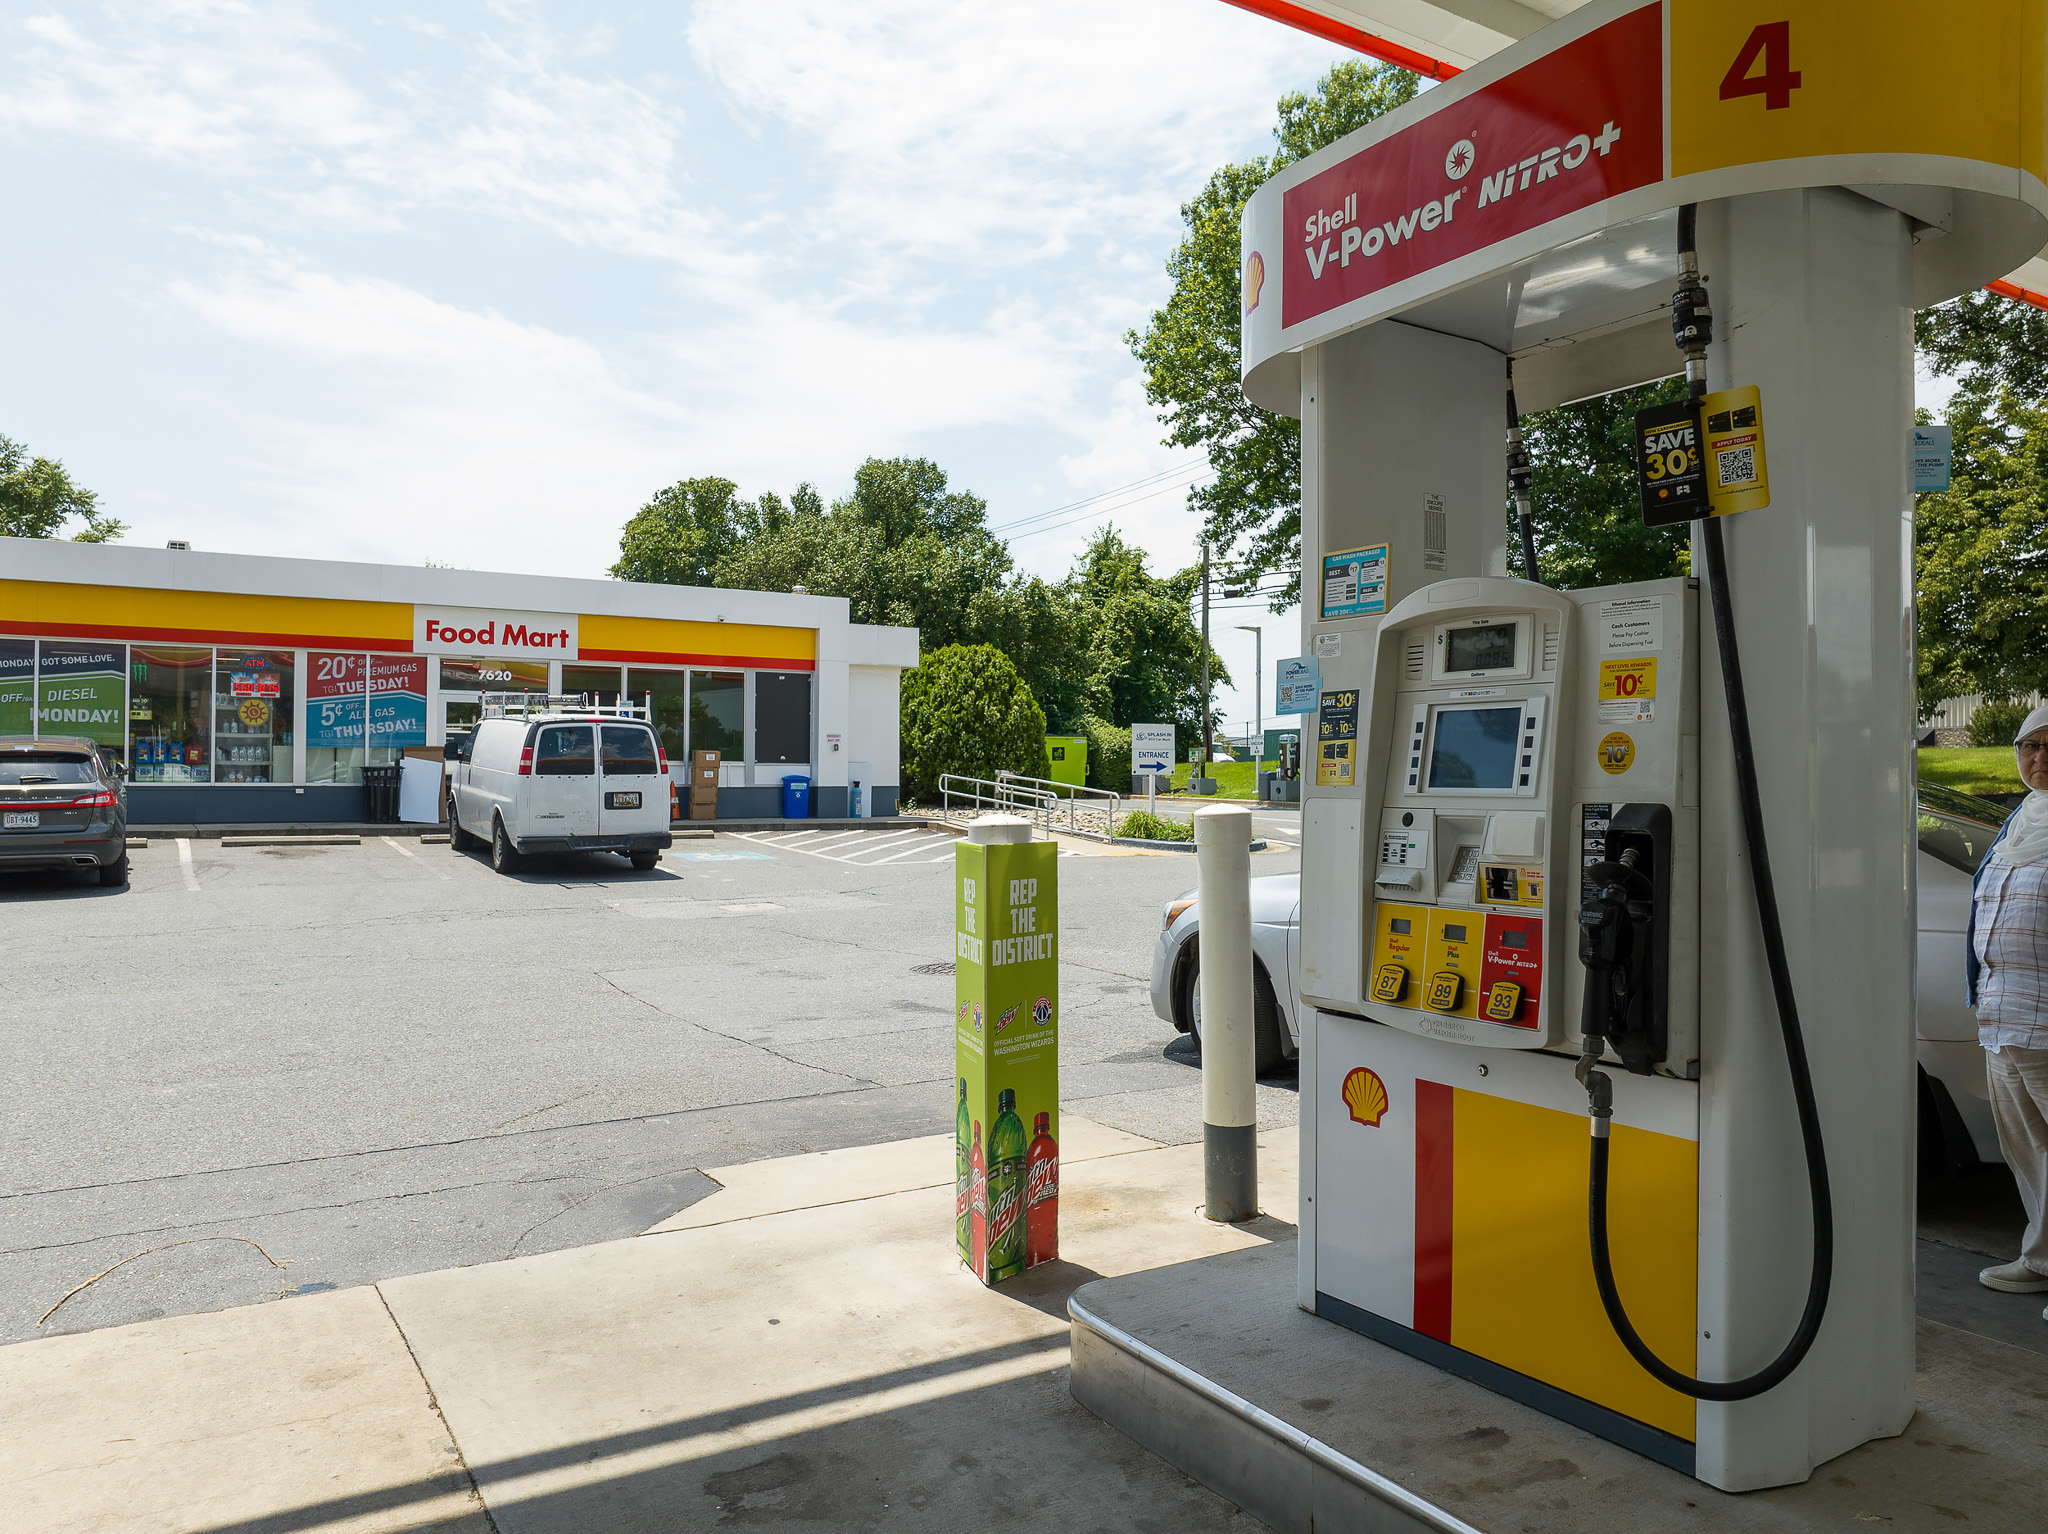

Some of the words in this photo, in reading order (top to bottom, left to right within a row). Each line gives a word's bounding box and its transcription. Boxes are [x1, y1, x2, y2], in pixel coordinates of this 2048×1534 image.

[1719, 20, 1801, 111] 4
[1304, 192, 1358, 244] Shell
[1304, 187, 1461, 281] V-Power
[1645, 428, 1695, 454] SAVE
[1716, 439, 1733, 448] APPLY
[1734, 436, 1752, 445] TODAY
[1342, 552, 1356, 561] WASH
[1356, 548, 1381, 558] PACKAGES
[426, 620, 495, 645] Food
[502, 624, 569, 648] Mart
[41, 658, 60, 666] GOT
[61, 655, 88, 665] SOME
[89, 654, 116, 663] LOVE.
[245, 659, 265, 668] ATM
[357, 664, 400, 677] PREMIUM
[401, 663, 418, 673] GAS
[478, 670, 512, 681] 7620
[47, 688, 98, 702] DIESEL
[1322, 699, 1336, 707] SAVE
[374, 707, 396, 718] GAS
[1138, 751, 1170, 759] ENTRANCE
[964, 877, 976, 904] REP
[1010, 878, 1037, 906] REP
[964, 906, 976, 934] THE
[1010, 907, 1036, 934] THE
[957, 932, 983, 966] DISTRICT
[992, 933, 1054, 966] DISTRICT
[1388, 943, 1411, 952] Regular
[1447, 951, 1460, 959] Plus
[1487, 956, 1516, 967] V-Power
[1380, 976, 1398, 989] 87
[1434, 983, 1452, 998] 89
[1493, 994, 1513, 1010] 93
[1432, 1019, 1465, 1031] GILBARCO
[993, 1042, 1031, 1056] WASHINGTON
[1030, 1037, 1055, 1049] WIZARDS
[994, 1038, 1013, 1047] OFFICIAL
